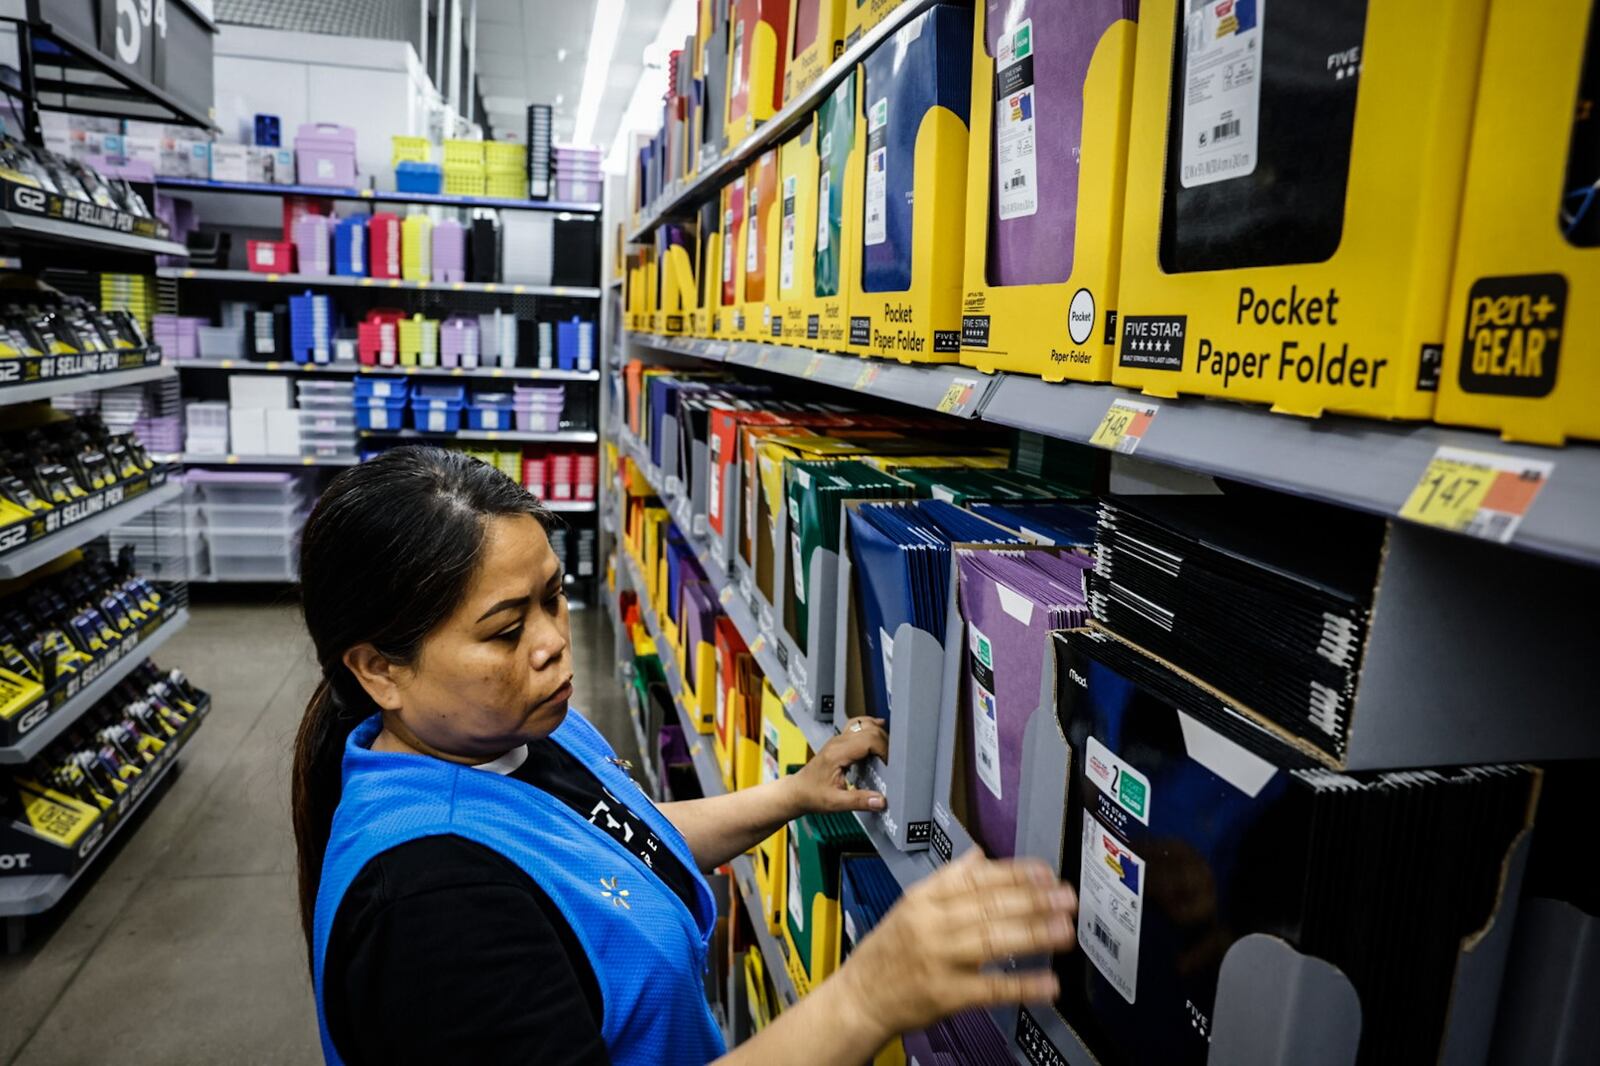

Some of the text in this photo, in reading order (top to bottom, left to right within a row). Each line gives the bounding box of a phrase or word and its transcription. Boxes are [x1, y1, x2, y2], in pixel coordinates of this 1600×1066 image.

[1326, 46, 1360, 70] FIVE
[14, 186, 46, 212] G2
[63, 197, 77, 219] #1
[77, 202, 116, 229] SELLING
[116, 211, 135, 232] PEN
[884, 302, 912, 323] Pocket
[1071, 310, 1091, 322] Pocket
[1237, 286, 1339, 326] Pocket
[1469, 294, 1556, 340] pen+
[963, 319, 975, 328] FIVE
[1125, 322, 1181, 337] FIVE STAR
[874, 329, 925, 354] Paper Folder
[1472, 328, 1547, 377] GEAR
[40, 357, 54, 378] #1
[56, 353, 99, 376] SELLING
[100, 352, 119, 371] PEN
[1051, 349, 1092, 364] Paper Folder
[1196, 338, 1388, 389] Paper Folder
[62, 493, 104, 526] SELLING
[105, 486, 124, 508] PEN
[17, 700, 49, 734] G2
[1099, 794, 1111, 809] FIVE
[1186, 999, 1208, 1029] FIVE
[1020, 1011, 1040, 1044] FIVE
